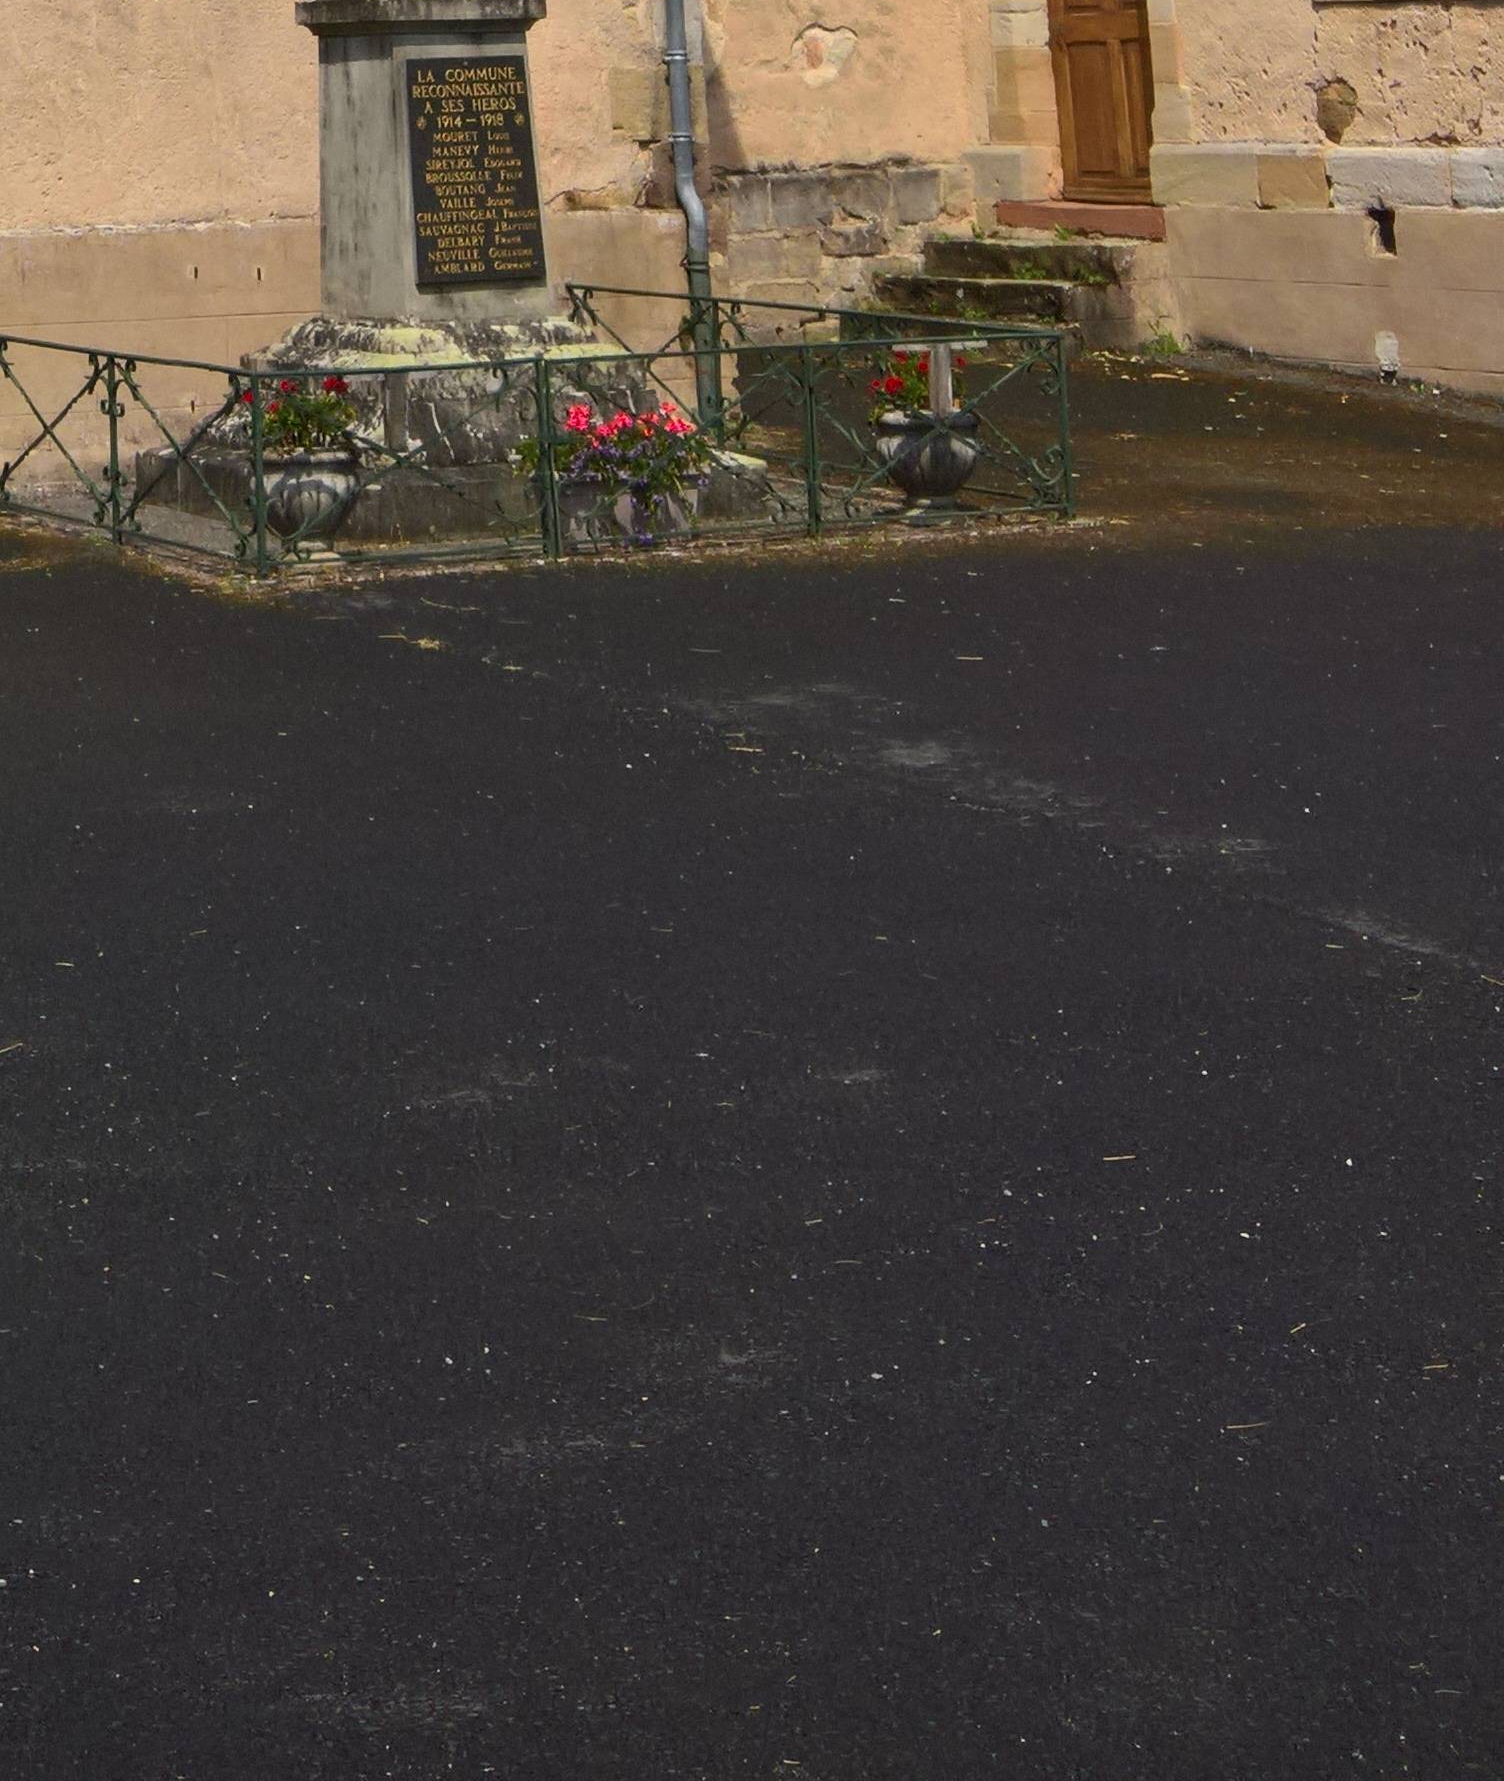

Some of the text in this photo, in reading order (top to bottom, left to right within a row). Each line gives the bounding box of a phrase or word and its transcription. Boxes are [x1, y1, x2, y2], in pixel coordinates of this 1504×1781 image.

[417, 66, 516, 83] LA COMMUNE
[411, 81, 525, 98] RECONNAISSANTE
[424, 97, 516, 114] A SES HEROS
[437, 115, 463, 129] 1914
[479, 113, 505, 126] 1918
[432, 131, 478, 143] MOURET
[432, 144, 479, 157] MANEVY
